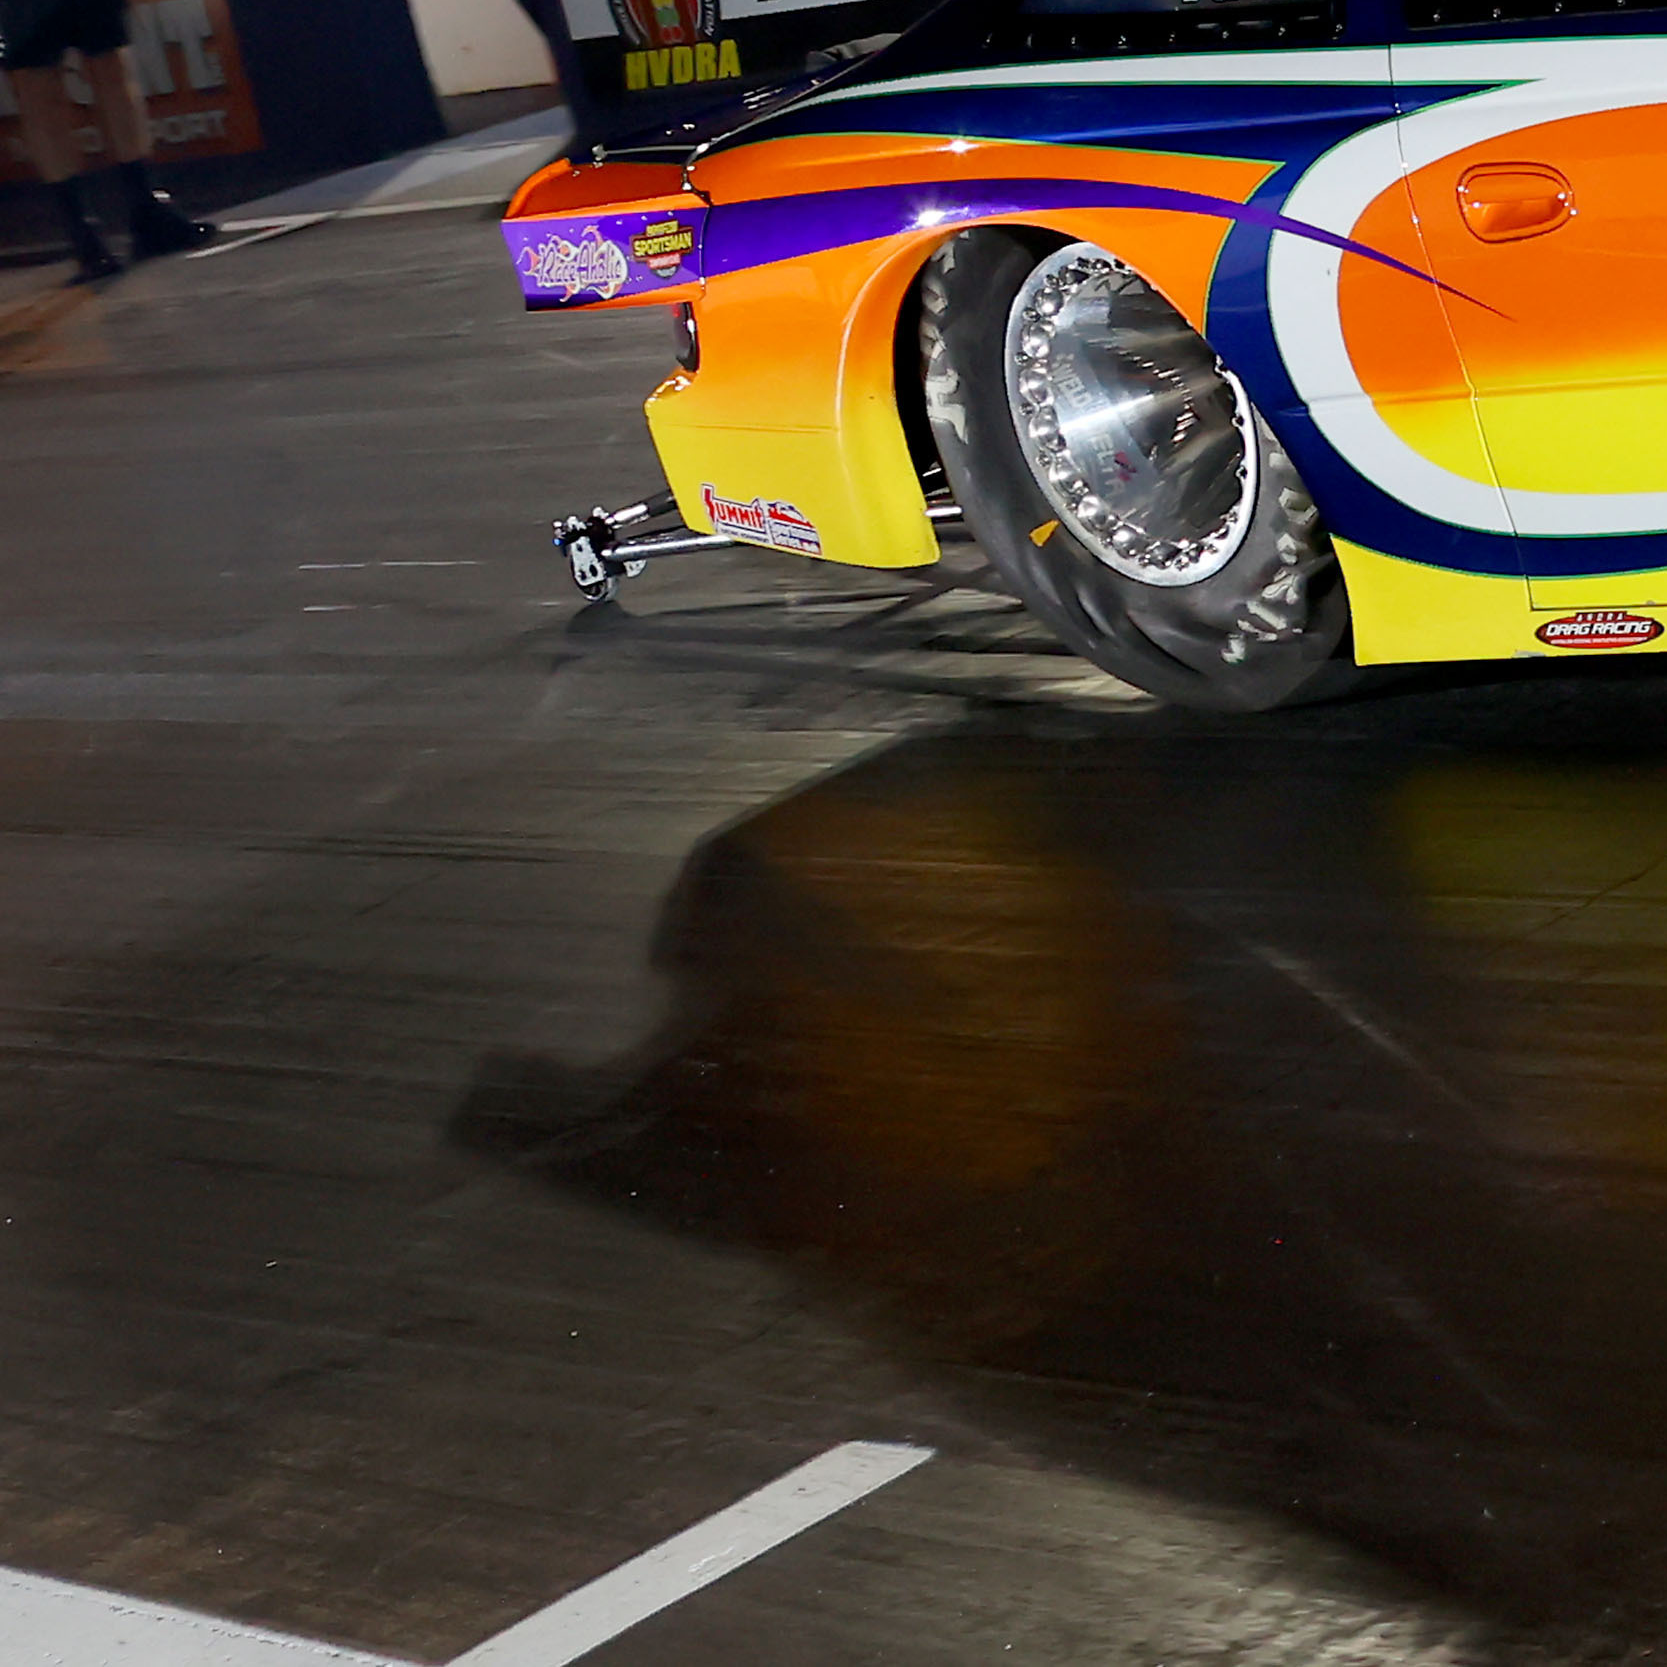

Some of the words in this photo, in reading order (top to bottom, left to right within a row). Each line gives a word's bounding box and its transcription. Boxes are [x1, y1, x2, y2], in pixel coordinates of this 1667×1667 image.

[624, 38, 743, 91] HVDRA
[633, 231, 693, 257] SPORTSMAN
[702, 486, 765, 532] SUMMIT
[1545, 623, 1592, 637] DRAG
[1591, 620, 1653, 634] RACING
